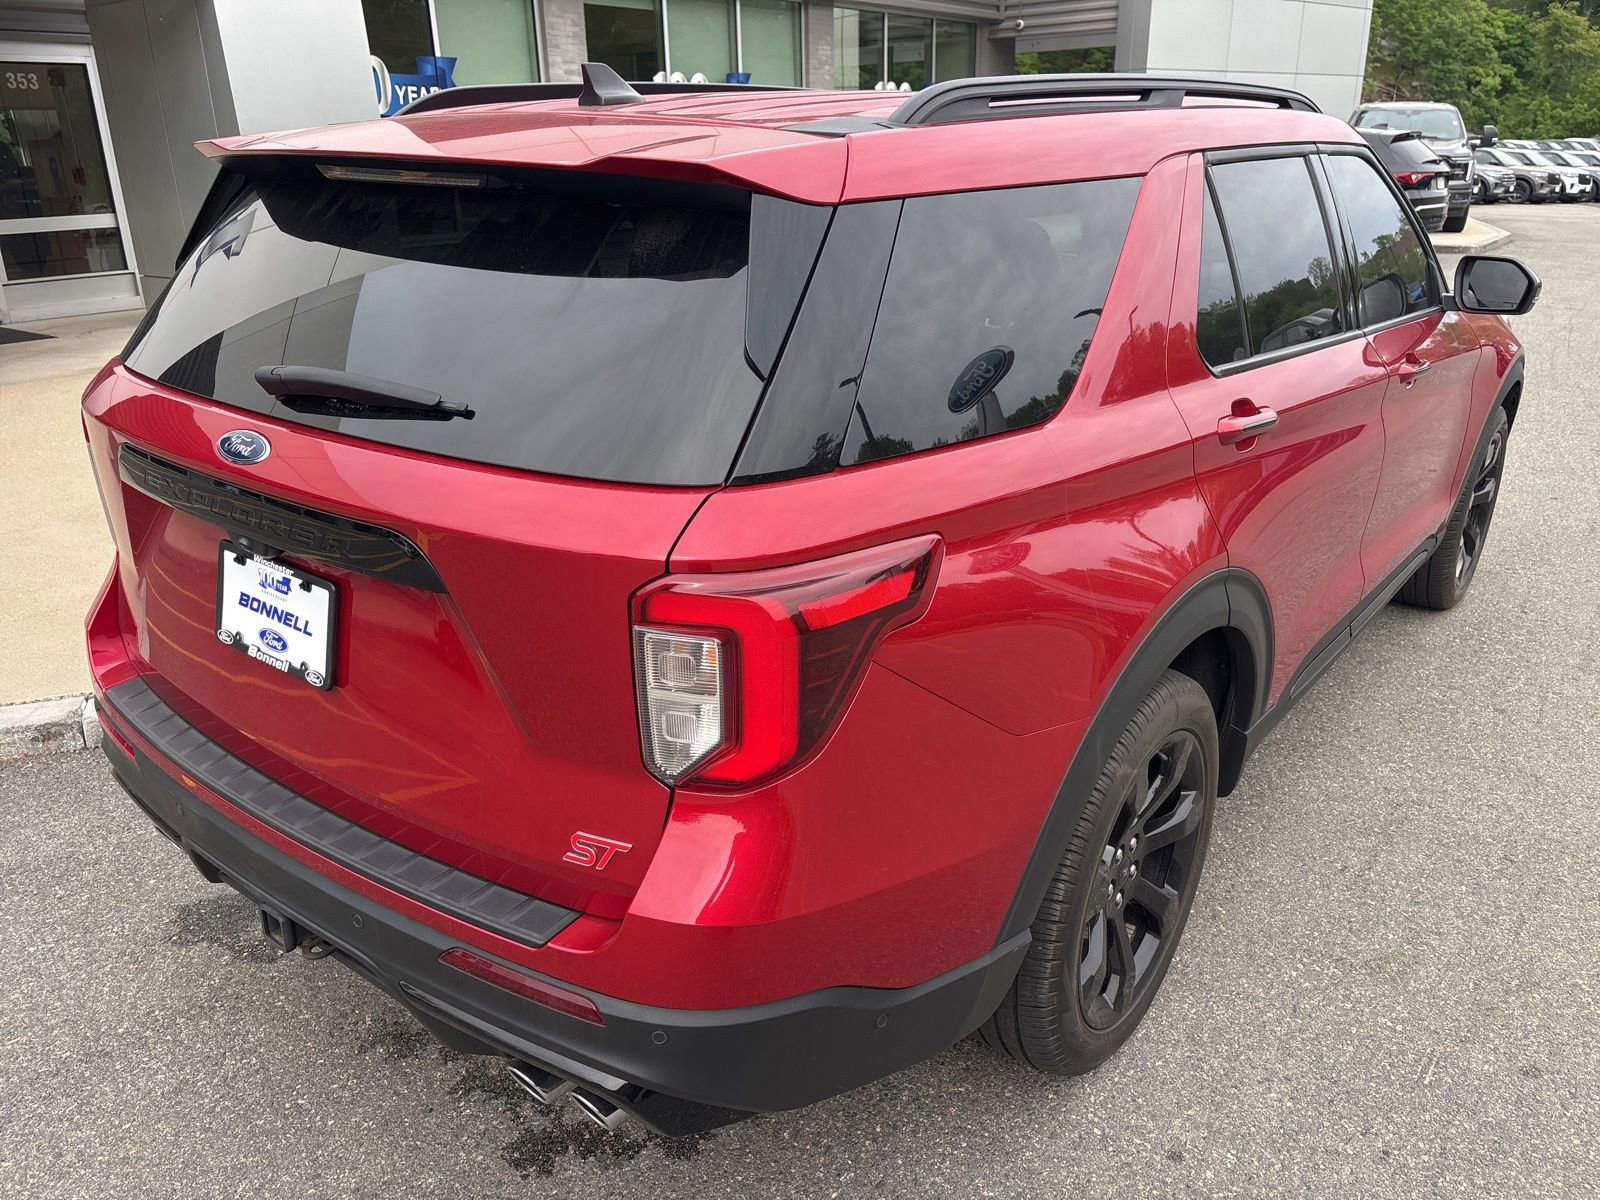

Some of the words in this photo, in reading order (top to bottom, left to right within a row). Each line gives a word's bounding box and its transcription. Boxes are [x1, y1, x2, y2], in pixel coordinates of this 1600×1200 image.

[5, 72, 40, 90] 353
[224, 434, 257, 457] Ford
[144, 469, 351, 556] EXPLORER
[253, 553, 294, 576] Winchester
[238, 591, 313, 637] BONNELL
[263, 630, 283, 651] Ford
[247, 645, 289, 672] Bonnell
[562, 831, 632, 870] ST
